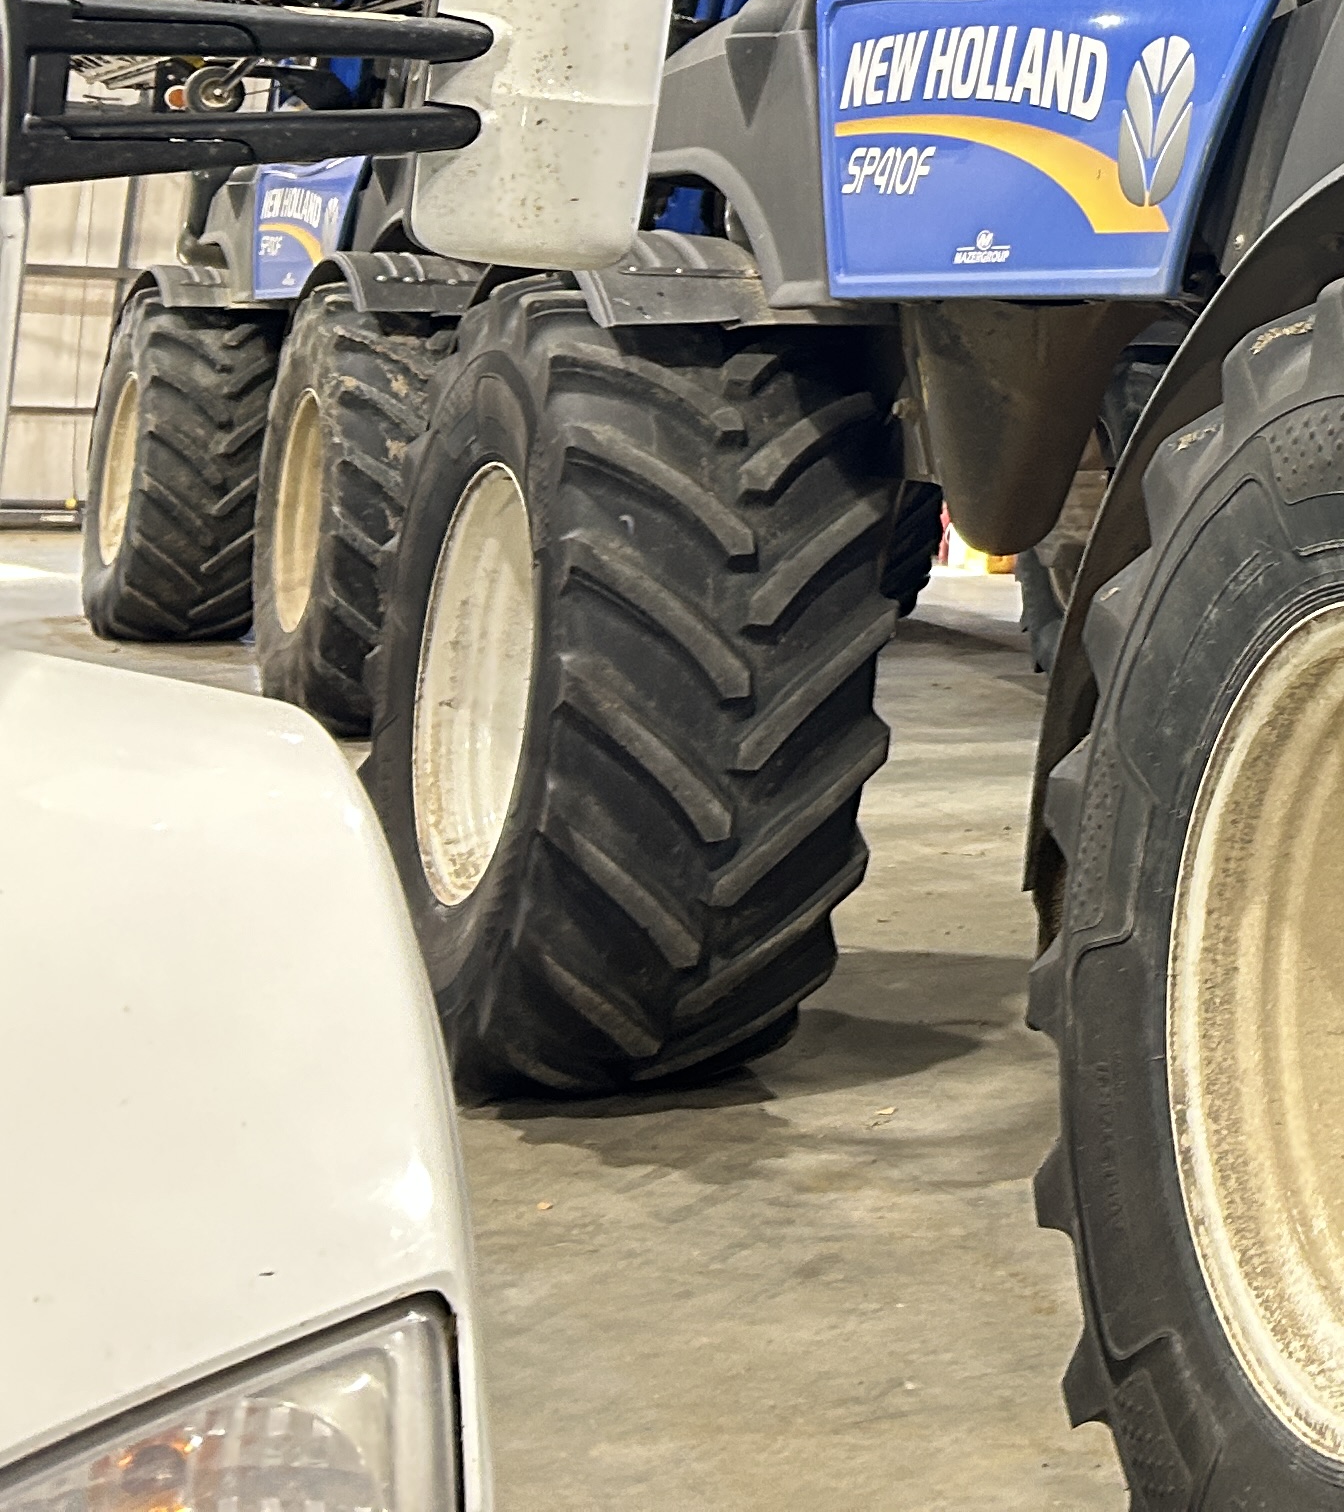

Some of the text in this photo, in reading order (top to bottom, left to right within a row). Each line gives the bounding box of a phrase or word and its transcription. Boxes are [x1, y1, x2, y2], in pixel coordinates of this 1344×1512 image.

[839, 25, 1108, 121] NEW HOLLAND
[841, 146, 936, 195] SP410F
[280, 187, 323, 228] HOLLAND
